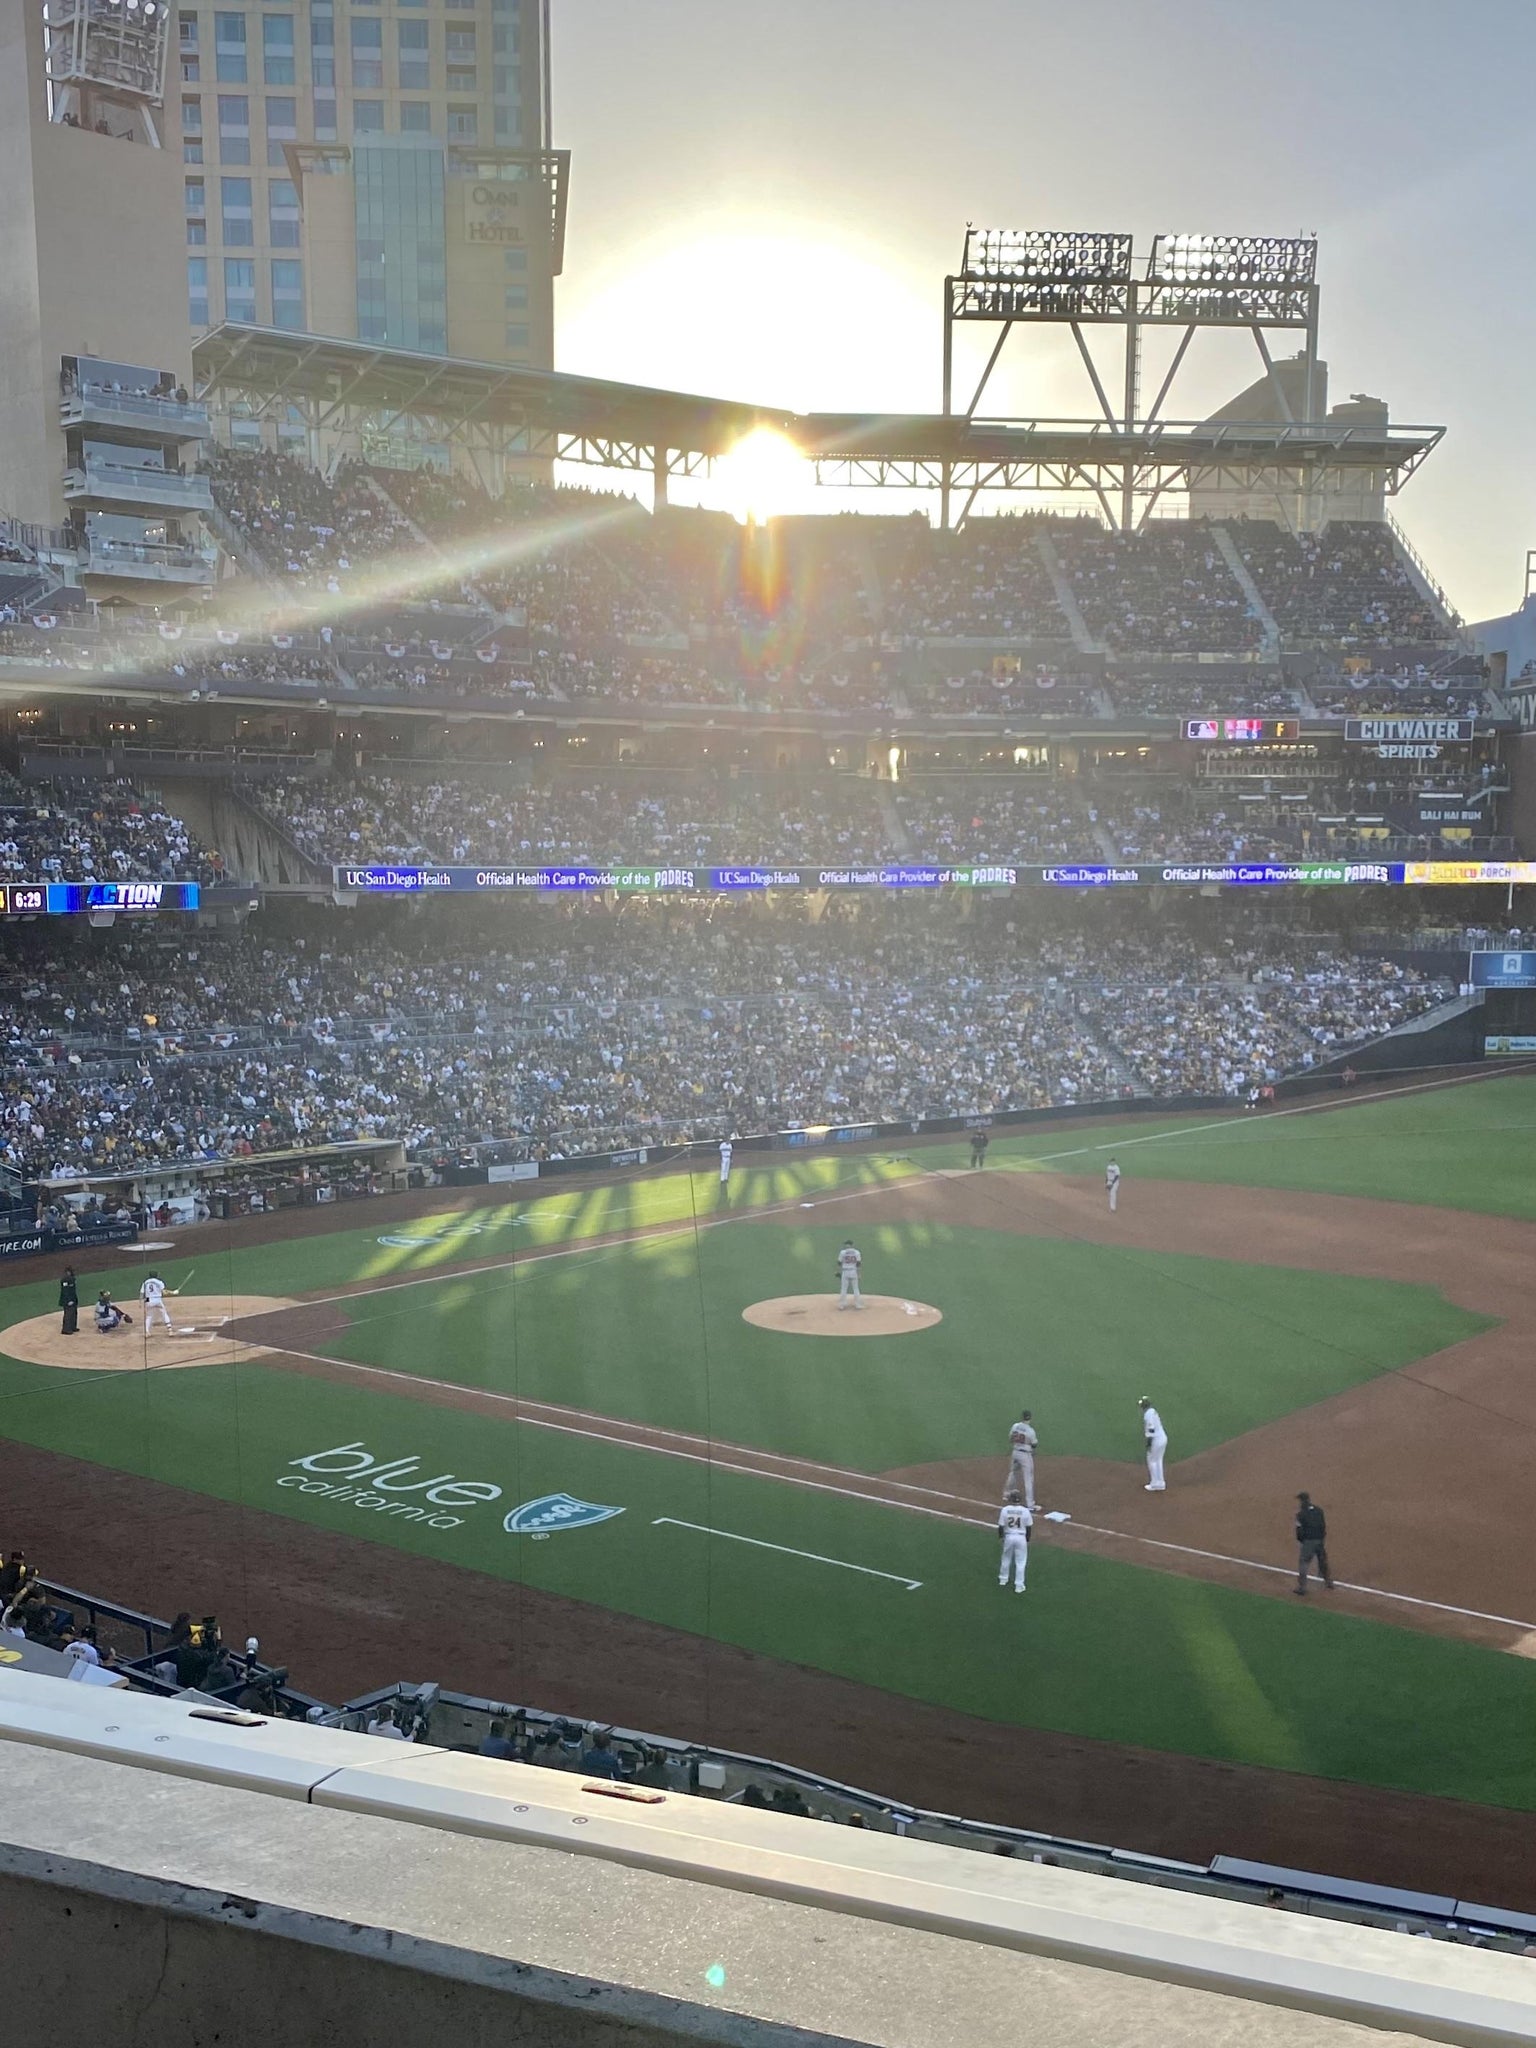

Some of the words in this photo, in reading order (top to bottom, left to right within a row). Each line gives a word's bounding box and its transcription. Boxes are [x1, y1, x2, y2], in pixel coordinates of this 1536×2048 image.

[473, 186, 519, 207] OMNI
[469, 222, 524, 241] HOTEL
[1360, 721, 1459, 739] CUTWATER
[1379, 745, 1438, 758] SPIRITS
[1462, 811, 1482, 820] RUM
[346, 872, 364, 885] UC
[365, 872, 386, 885] San
[387, 872, 417, 888] Diego
[418, 872, 451, 885] Health
[476, 872, 514, 886] Official
[516, 872, 550, 885] Health
[552, 872, 576, 885] Care
[578, 872, 619, 885] Provider
[622, 872, 633, 885] of
[634, 872, 650, 884] the
[654, 870, 694, 888] PADRES
[719, 872, 733, 885] UC
[734, 872, 750, 885] San
[750, 872, 774, 886] Diego
[774, 872, 800, 884] Health
[819, 872, 849, 884] Official
[851, 871, 878, 884] Health
[879, 871, 898, 883] Care
[900, 870, 937, 883] Provider
[938, 870, 952, 882] of
[952, 870, 969, 882] the
[972, 868, 1017, 885] PADRES
[1042, 870, 1060, 882] UC
[1060, 870, 1078, 882] San
[1079, 869, 1106, 884] Diego
[1107, 868, 1139, 882] Health
[1162, 868, 1200, 881] Official
[1202, 868, 1237, 880] Health
[1238, 867, 1264, 880] Care
[1265, 867, 1310, 880] Provider
[1310, 867, 1324, 880] of
[1324, 867, 1342, 880] the
[1343, 864, 1389, 882] PADRES
[1480, 868, 1512, 878] PORCH
[15, 891, 42, 908] 6:29
[87, 884, 163, 904] ACTION
[288, 1442, 503, 1506] blue
[276, 1475, 466, 1530] california
[1008, 1516, 1021, 1528] 24
